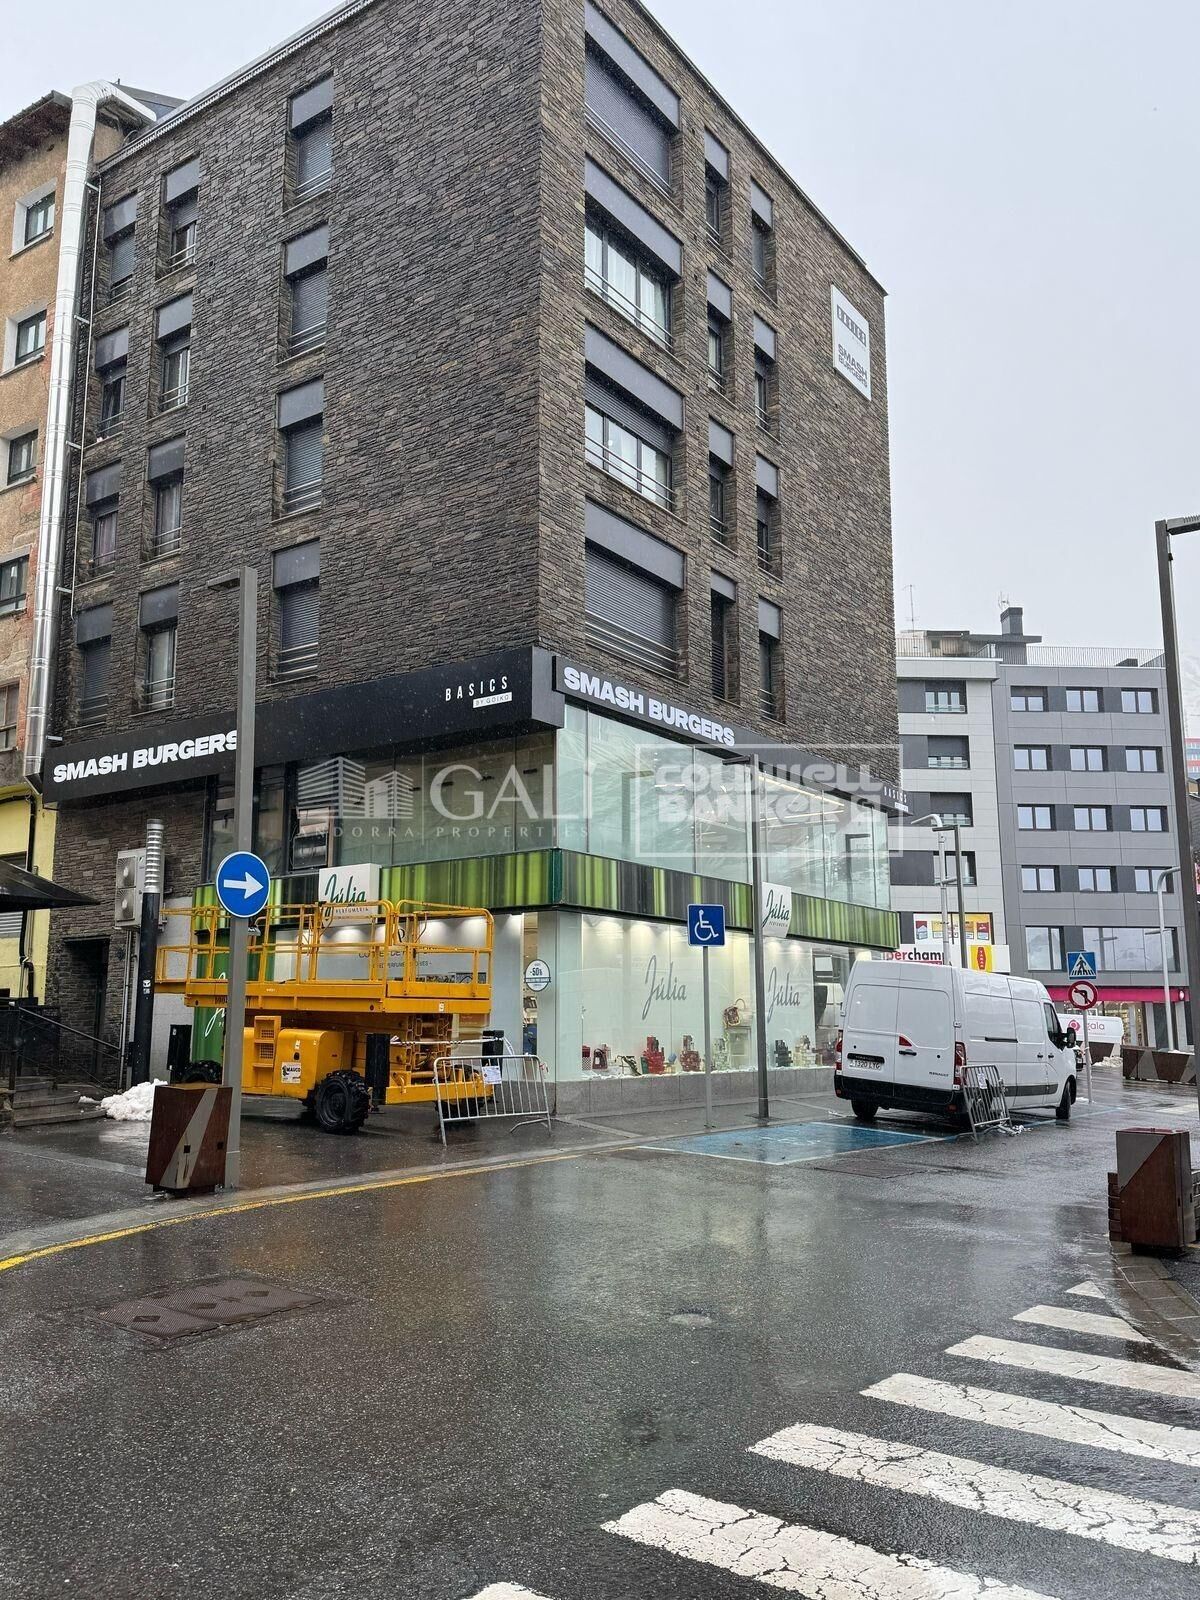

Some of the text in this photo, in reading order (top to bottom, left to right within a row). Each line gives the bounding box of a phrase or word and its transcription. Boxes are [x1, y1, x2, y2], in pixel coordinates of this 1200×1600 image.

[445, 676, 508, 701] BASICS
[564, 667, 735, 747] SMASH BURGERS
[53, 730, 237, 782] SMASH BURGERS
[761, 889, 789, 928] Júlia
[642, 955, 687, 1020] Júlia
[767, 966, 800, 1023] Júlia
